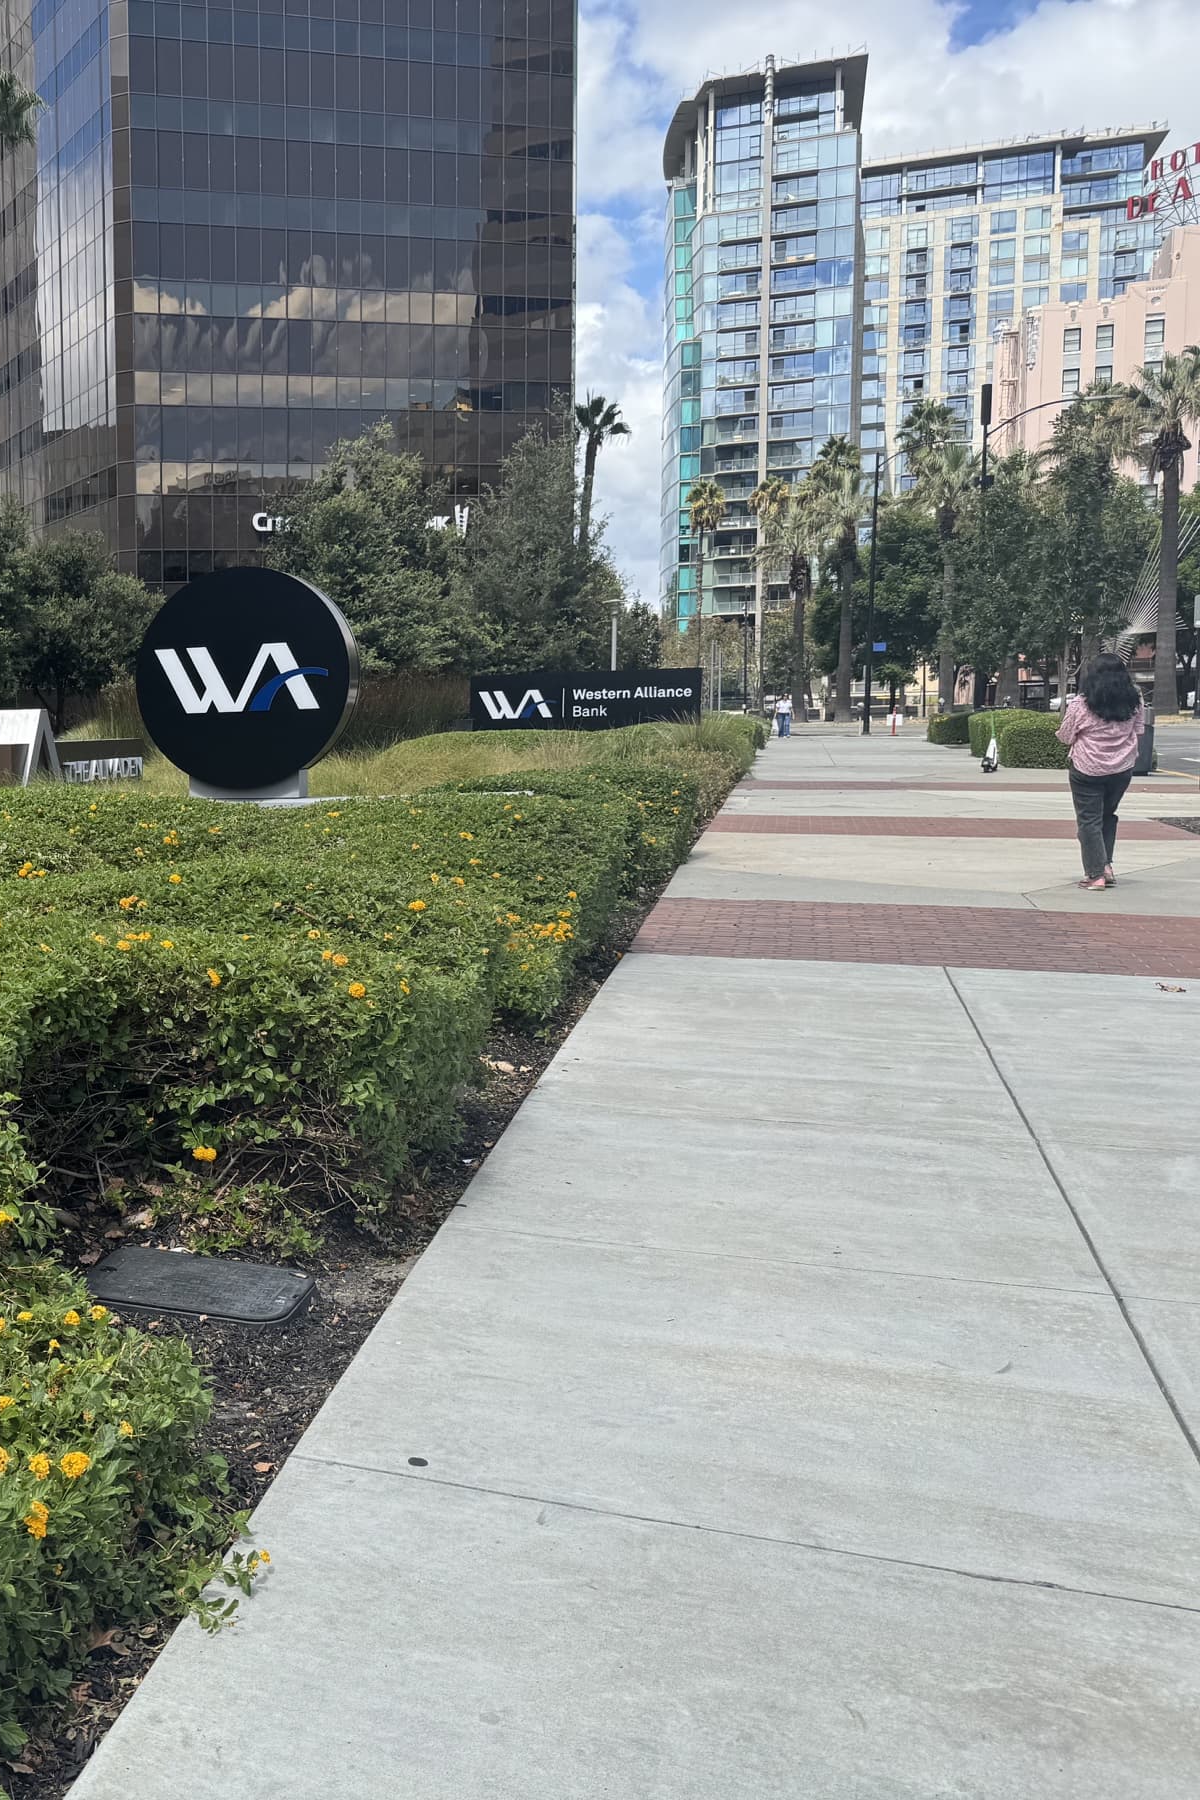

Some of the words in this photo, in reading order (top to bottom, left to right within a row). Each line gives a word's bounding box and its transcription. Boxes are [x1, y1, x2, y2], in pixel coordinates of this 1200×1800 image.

[154, 642, 328, 714] WA
[478, 689, 553, 720] WA
[572, 687, 631, 701] Western
[633, 685, 693, 699] Alliance
[572, 705, 608, 718] Bank
[62, 760, 90, 782] THE
[90, 756, 143, 781] ALMADEN
